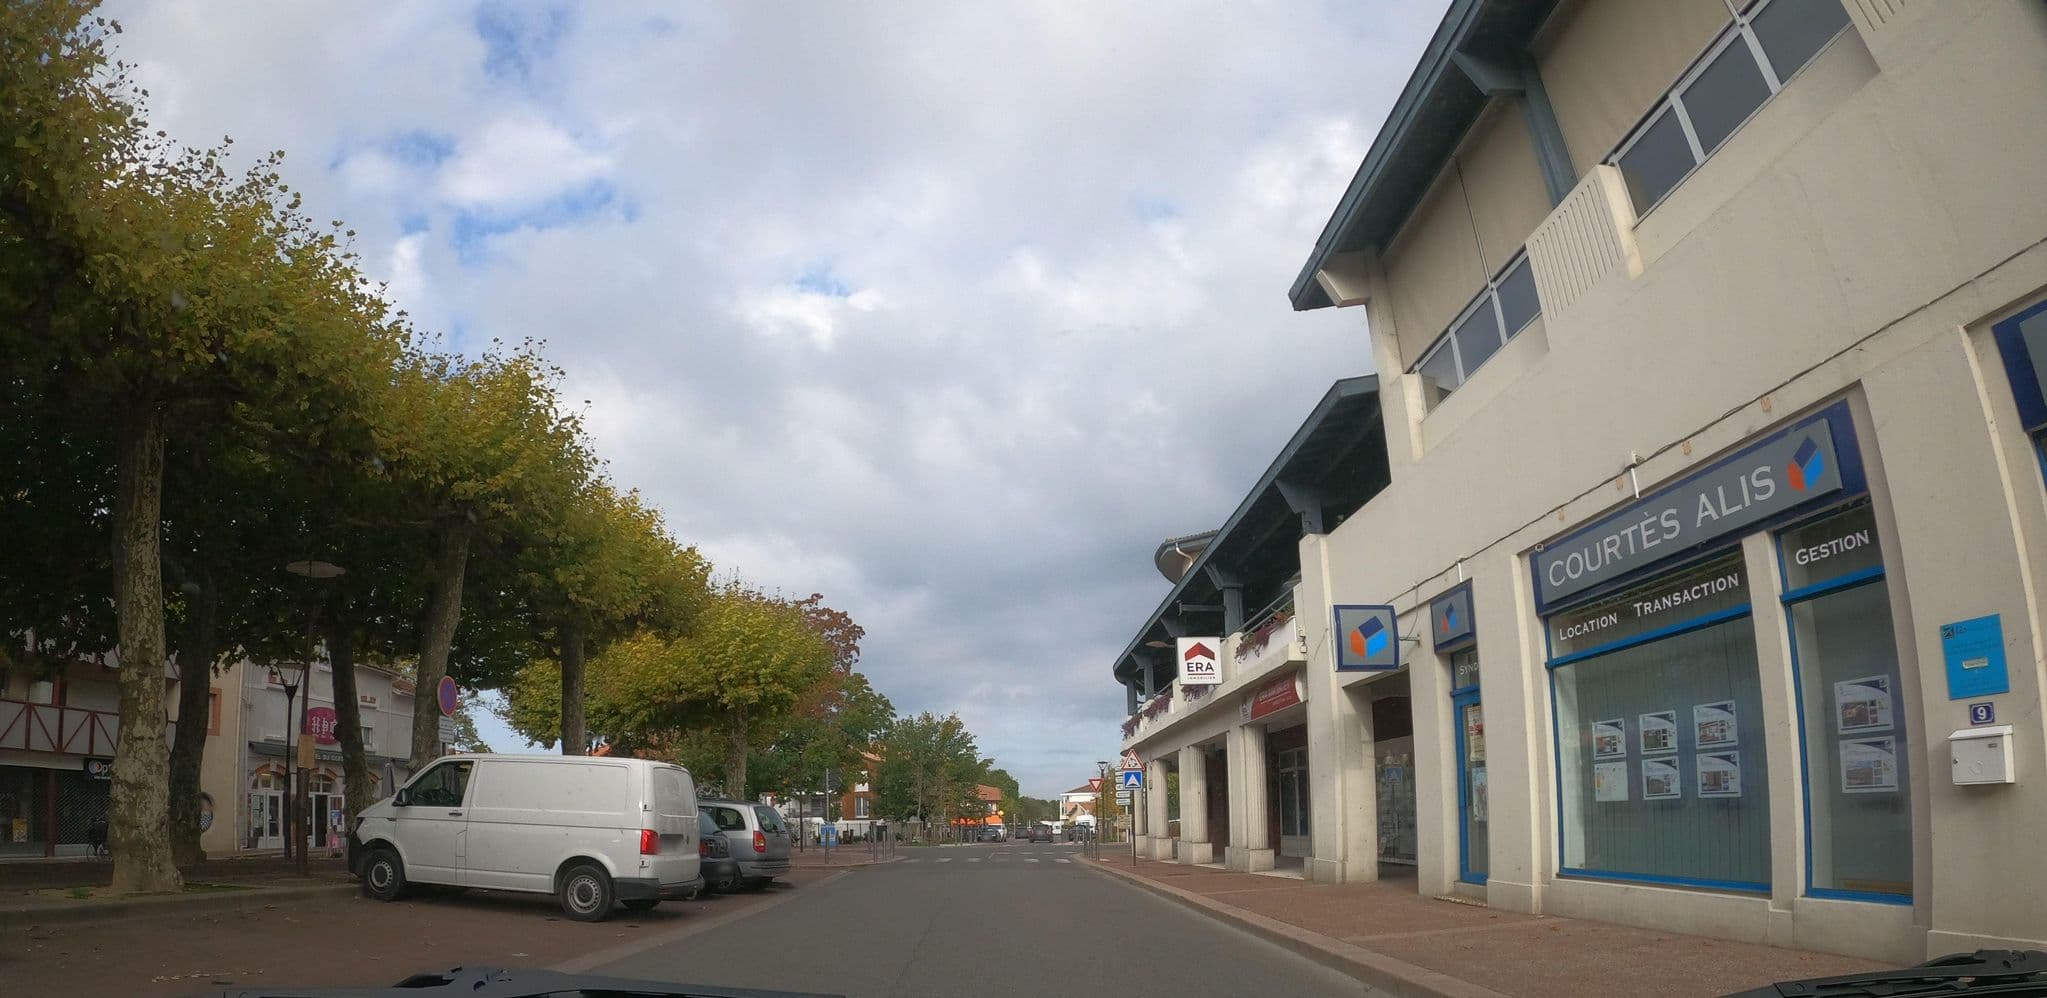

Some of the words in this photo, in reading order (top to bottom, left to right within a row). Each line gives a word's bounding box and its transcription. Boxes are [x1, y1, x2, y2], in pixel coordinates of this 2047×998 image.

[1549, 508, 1680, 587] COURTÈS
[1696, 465, 1776, 527] ALIS
[1796, 530, 1870, 565] GESTION
[1560, 613, 1618, 640] LOCATION
[1634, 573, 1739, 617] TRANSACTION
[1187, 662, 1215, 672] ERA
[1460, 662, 1480, 675] SYND
[1977, 706, 1986, 720] 9
